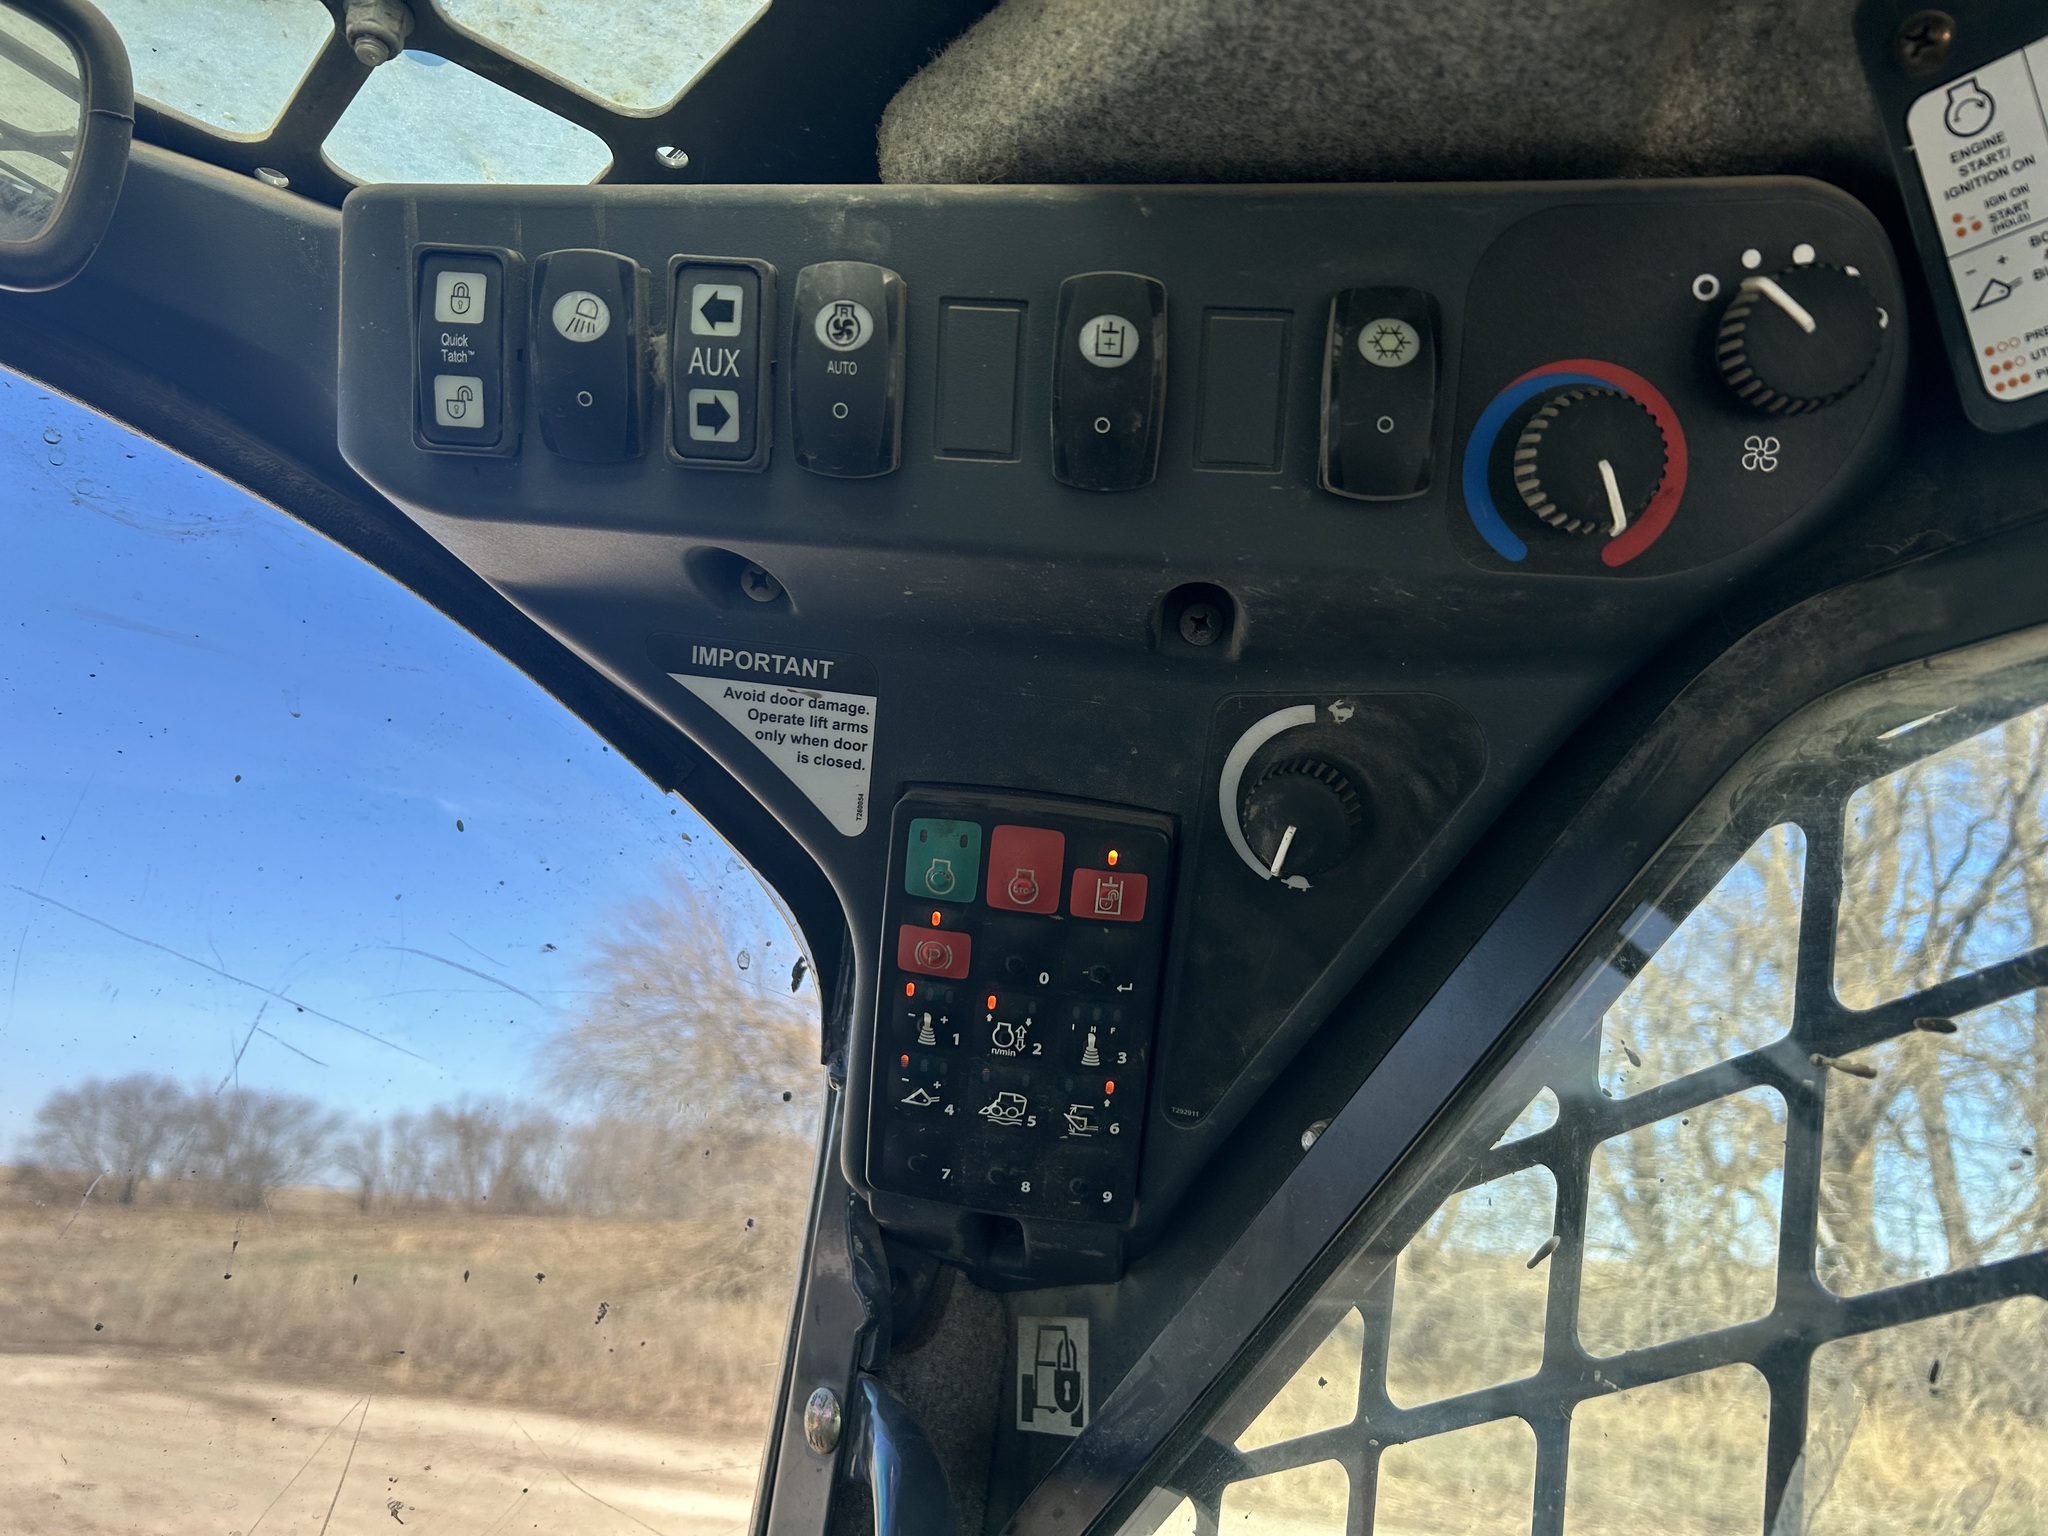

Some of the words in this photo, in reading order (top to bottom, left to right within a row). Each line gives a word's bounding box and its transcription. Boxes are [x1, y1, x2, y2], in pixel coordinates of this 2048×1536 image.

[1949, 130, 2007, 164] ENGINE
[1944, 164, 2010, 201] IGNITION
[2011, 153, 2036, 173] ON
[1984, 191, 2008, 209] IGN
[2009, 182, 2030, 199] ON
[1988, 199, 2030, 223] START
[441, 332, 469, 347] Quick
[687, 347, 740, 379] AUX
[827, 360, 858, 376] AUTO
[692, 645, 835, 680] IMPORTANT
[723, 686, 766, 703] Avoid
[770, 692, 804, 707] door
[808, 697, 870, 717] damage.
[747, 708, 806, 727] Operate
[809, 715, 829, 730] lift
[832, 720, 869, 734] arms
[755, 730, 786, 745] only
[790, 733, 829, 748] when
[833, 737, 869, 752] door
[797, 751, 809, 764] is
[813, 753, 866, 771] closed.
[1039, 971, 1050, 985] 0
[952, 1033, 960, 1045] 1
[991, 1047, 1016, 1057] n/min
[1032, 1043, 1042, 1055] 2
[1117, 1051, 1127, 1064] 3
[944, 1104, 955, 1116] 4
[1027, 1115, 1037, 1127] 5
[1109, 1122, 1120, 1135] 6
[941, 1168, 951, 1180] 7
[1020, 1181, 1031, 1193] 8
[1102, 1191, 1113, 1203] 9
